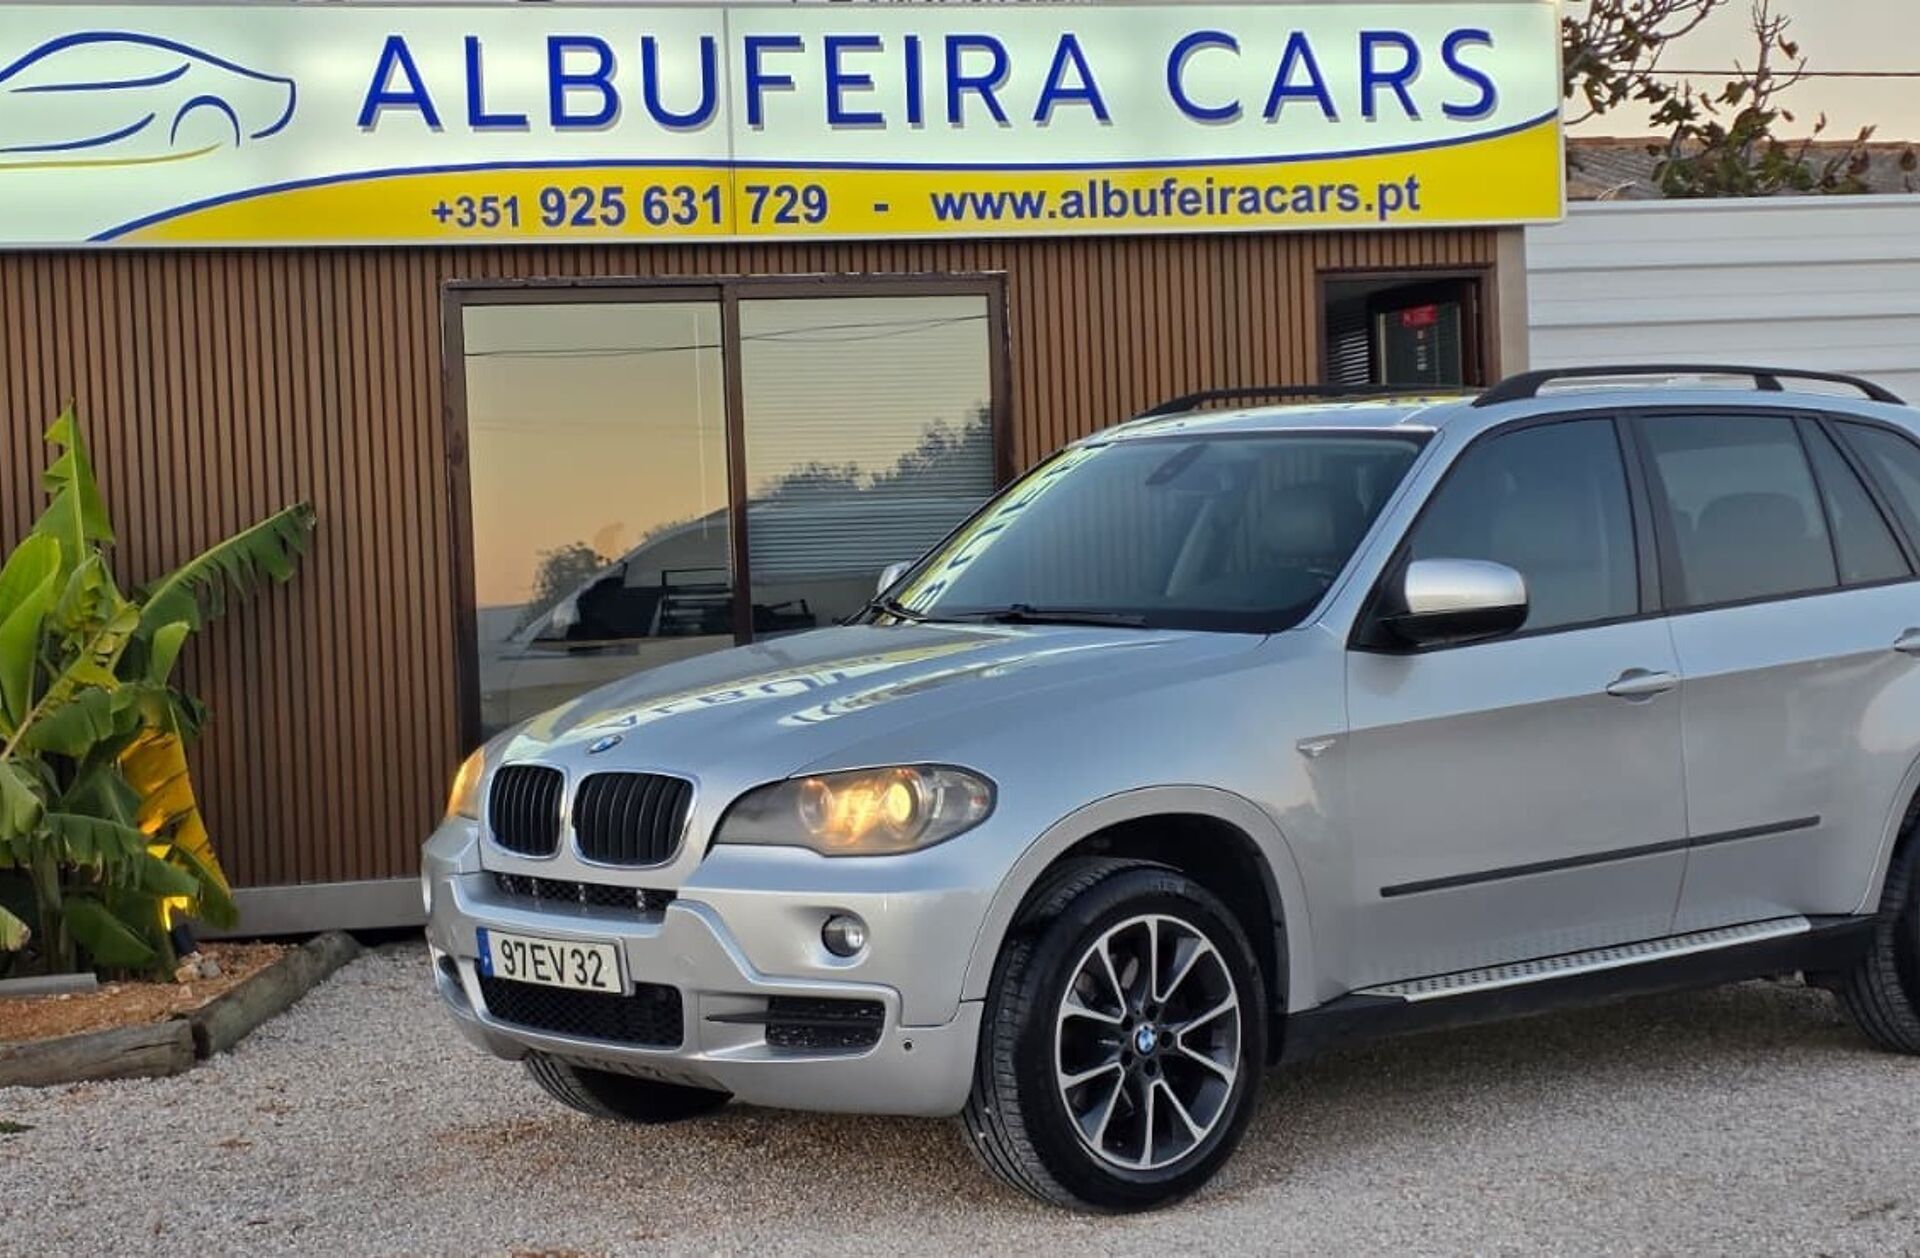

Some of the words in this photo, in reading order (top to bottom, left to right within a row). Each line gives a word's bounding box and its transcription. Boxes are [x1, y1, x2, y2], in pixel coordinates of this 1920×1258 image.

[357, 34, 1112, 132] ALBUFEIRA
[1166, 28, 1498, 123] CARS
[430, 196, 520, 228] +351
[539, 186, 627, 226] 925
[642, 185, 722, 225] 631
[745, 185, 828, 224] 729
[931, 175, 1420, 221] www.albufeiracars.pt
